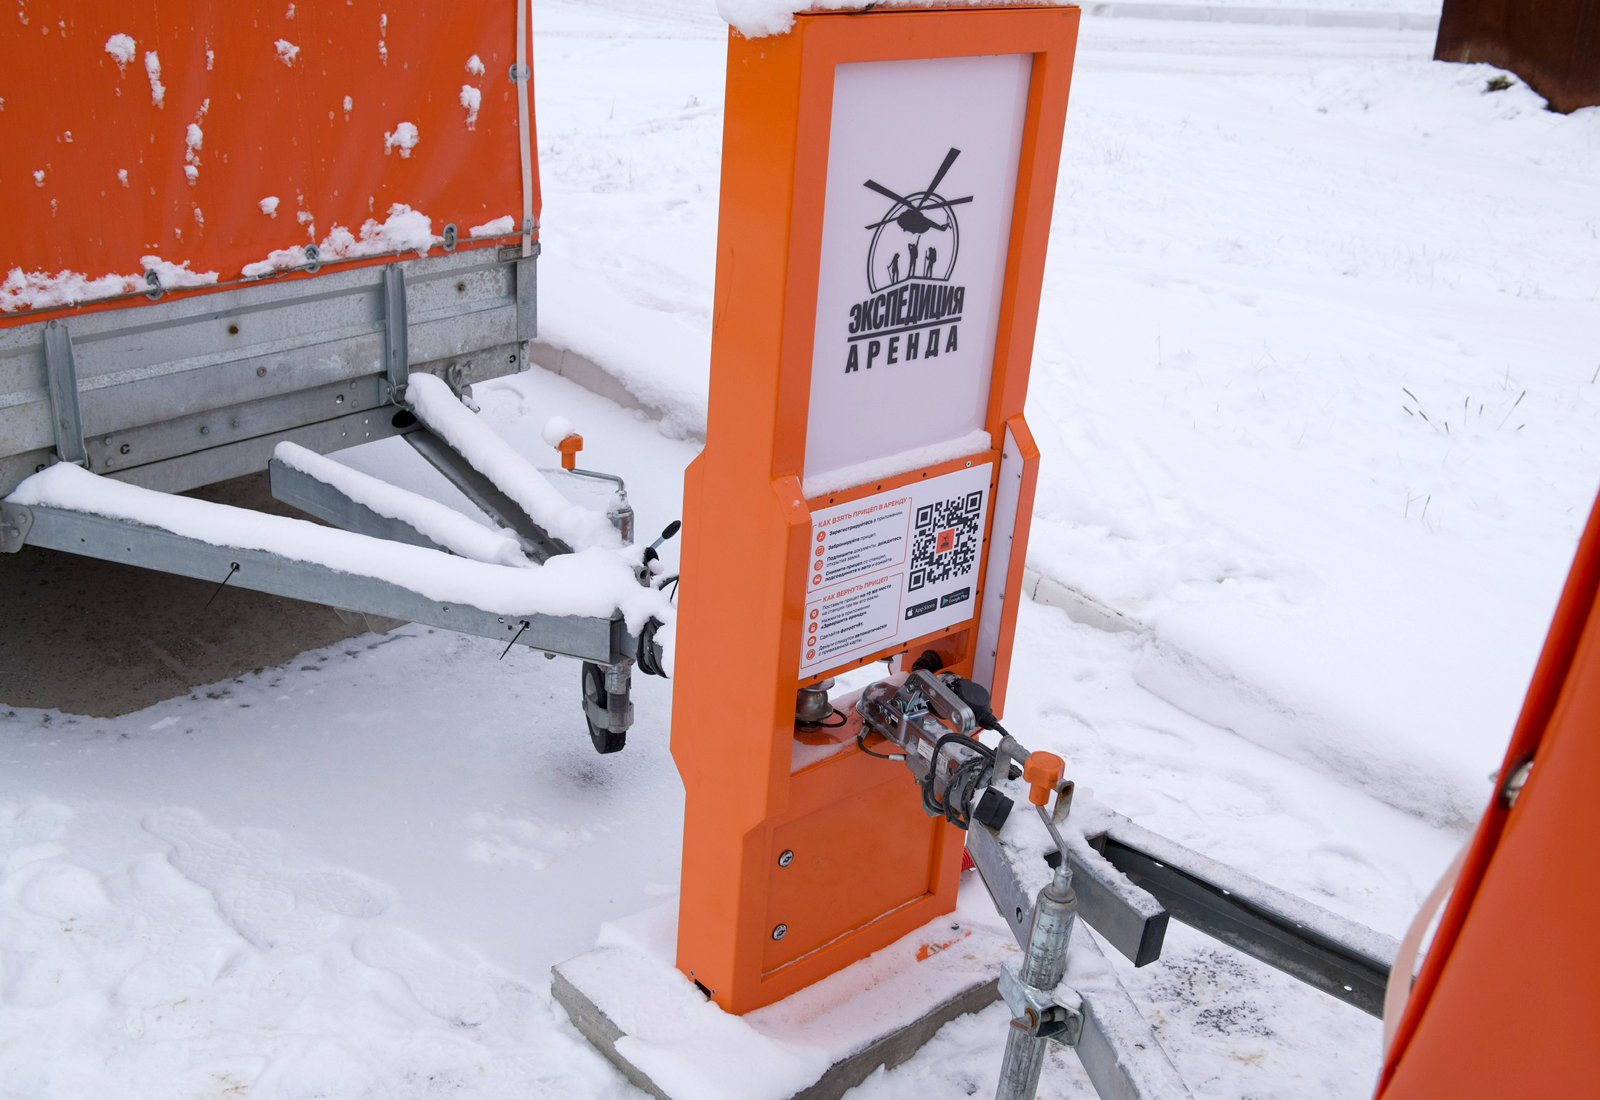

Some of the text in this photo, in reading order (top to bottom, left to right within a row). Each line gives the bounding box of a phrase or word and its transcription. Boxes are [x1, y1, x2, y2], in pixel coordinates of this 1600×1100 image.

[849, 283, 965, 333] ЭКСПЕДИЦИЯ
[845, 325, 957, 373] АРЕНДА
[818, 519, 831, 528] КАК
[832, 513, 852, 524] ВЗЯТЬ
[853, 505, 878, 517] ПРИЦЕП
[884, 497, 907, 508] АРЕНДУ
[823, 576, 888, 602] КАК ВЕРНУТЬ ПРИЦЕП
